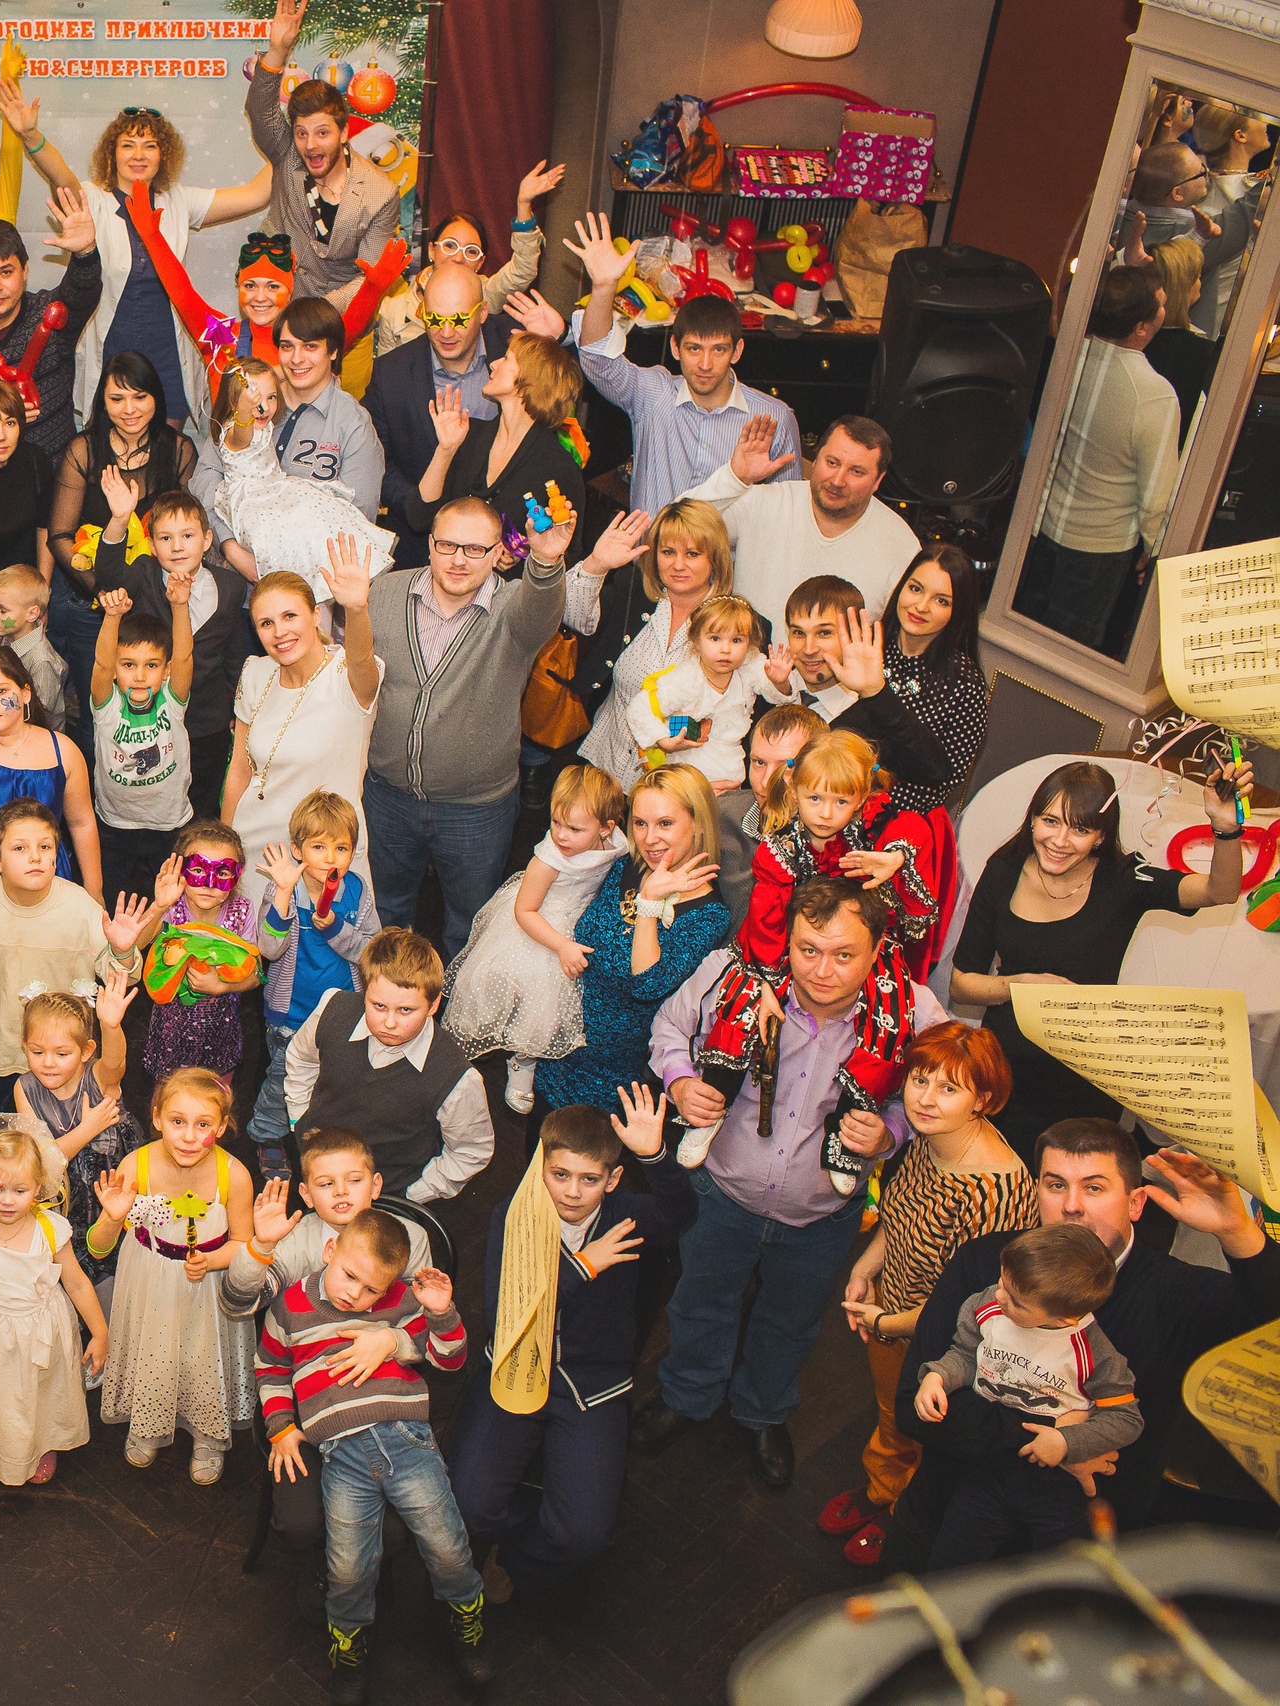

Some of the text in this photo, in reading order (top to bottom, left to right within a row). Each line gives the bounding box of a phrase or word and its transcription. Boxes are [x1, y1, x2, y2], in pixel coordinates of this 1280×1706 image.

[106, 20, 272, 39] ПРИКЛЮЧЕНИ
[358, 76, 381, 102] 4
[290, 438, 339, 481] 23
[113, 741, 174, 763] 19 79
[108, 760, 177, 787] LOS ANGELES
[1032, 1364, 1068, 1391] LANE
